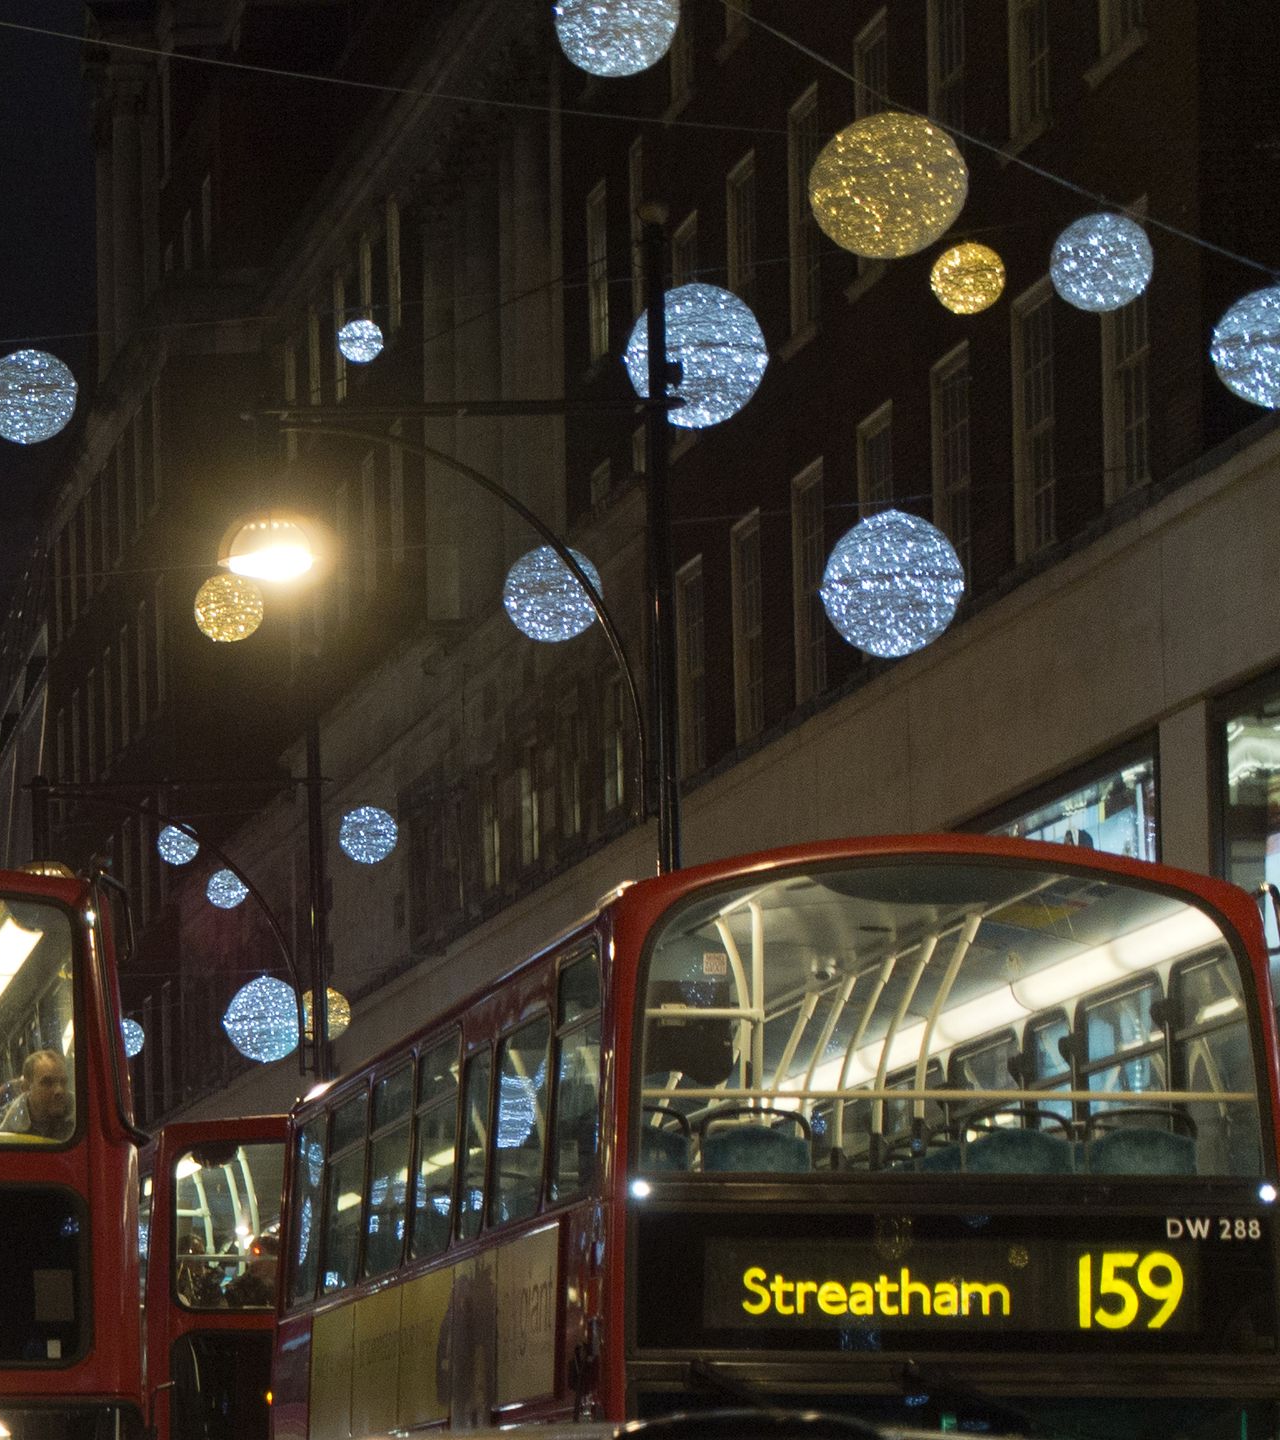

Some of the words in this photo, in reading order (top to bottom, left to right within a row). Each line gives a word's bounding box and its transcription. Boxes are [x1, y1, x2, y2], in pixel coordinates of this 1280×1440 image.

[1166, 1218, 1211, 1239] DW
[1219, 1219, 1262, 1240] 288
[742, 1265, 1011, 1316] Streatham
[1078, 1251, 1185, 1330] 159
